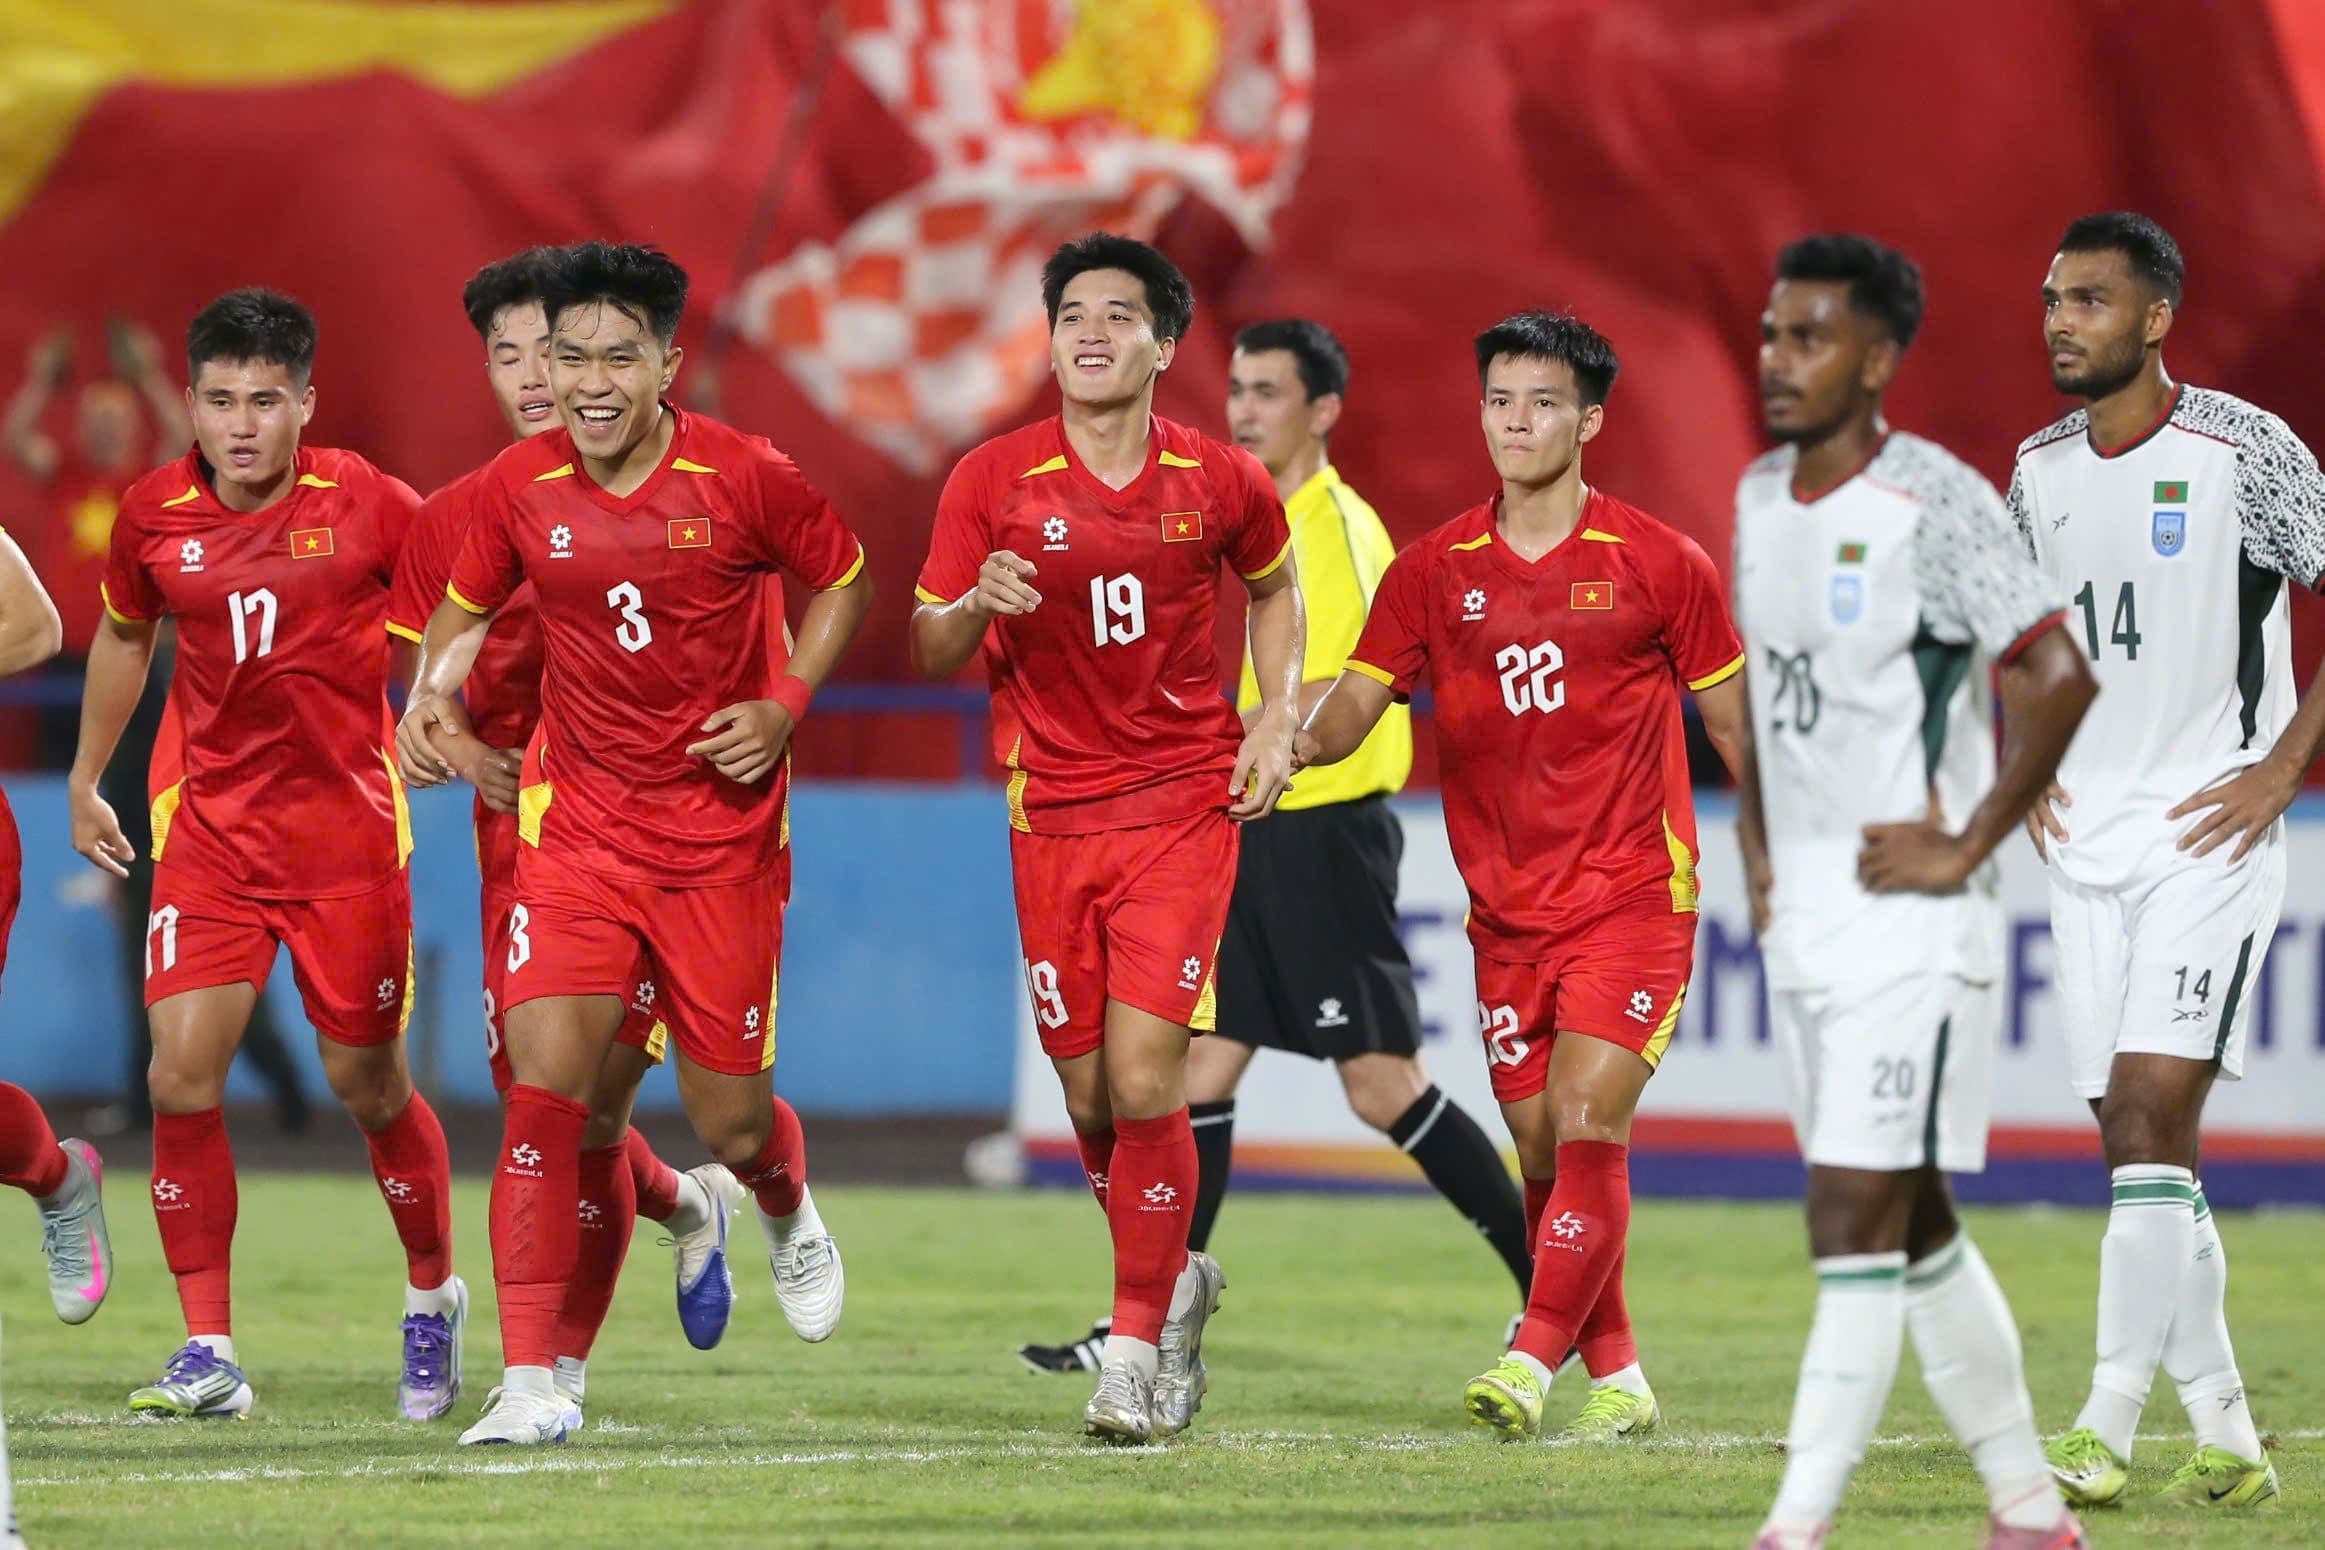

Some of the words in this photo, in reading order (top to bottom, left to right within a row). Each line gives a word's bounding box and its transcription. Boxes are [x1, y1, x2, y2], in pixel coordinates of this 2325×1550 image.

[227, 588, 277, 665] 17
[606, 580, 652, 653] 3
[1091, 573, 1145, 647] 19
[2074, 580, 2141, 661] 14
[1495, 639, 1565, 716] 22
[507, 901, 531, 975] 3
[2174, 965, 2212, 1004] 14
[1872, 1055, 1915, 1100] 20
